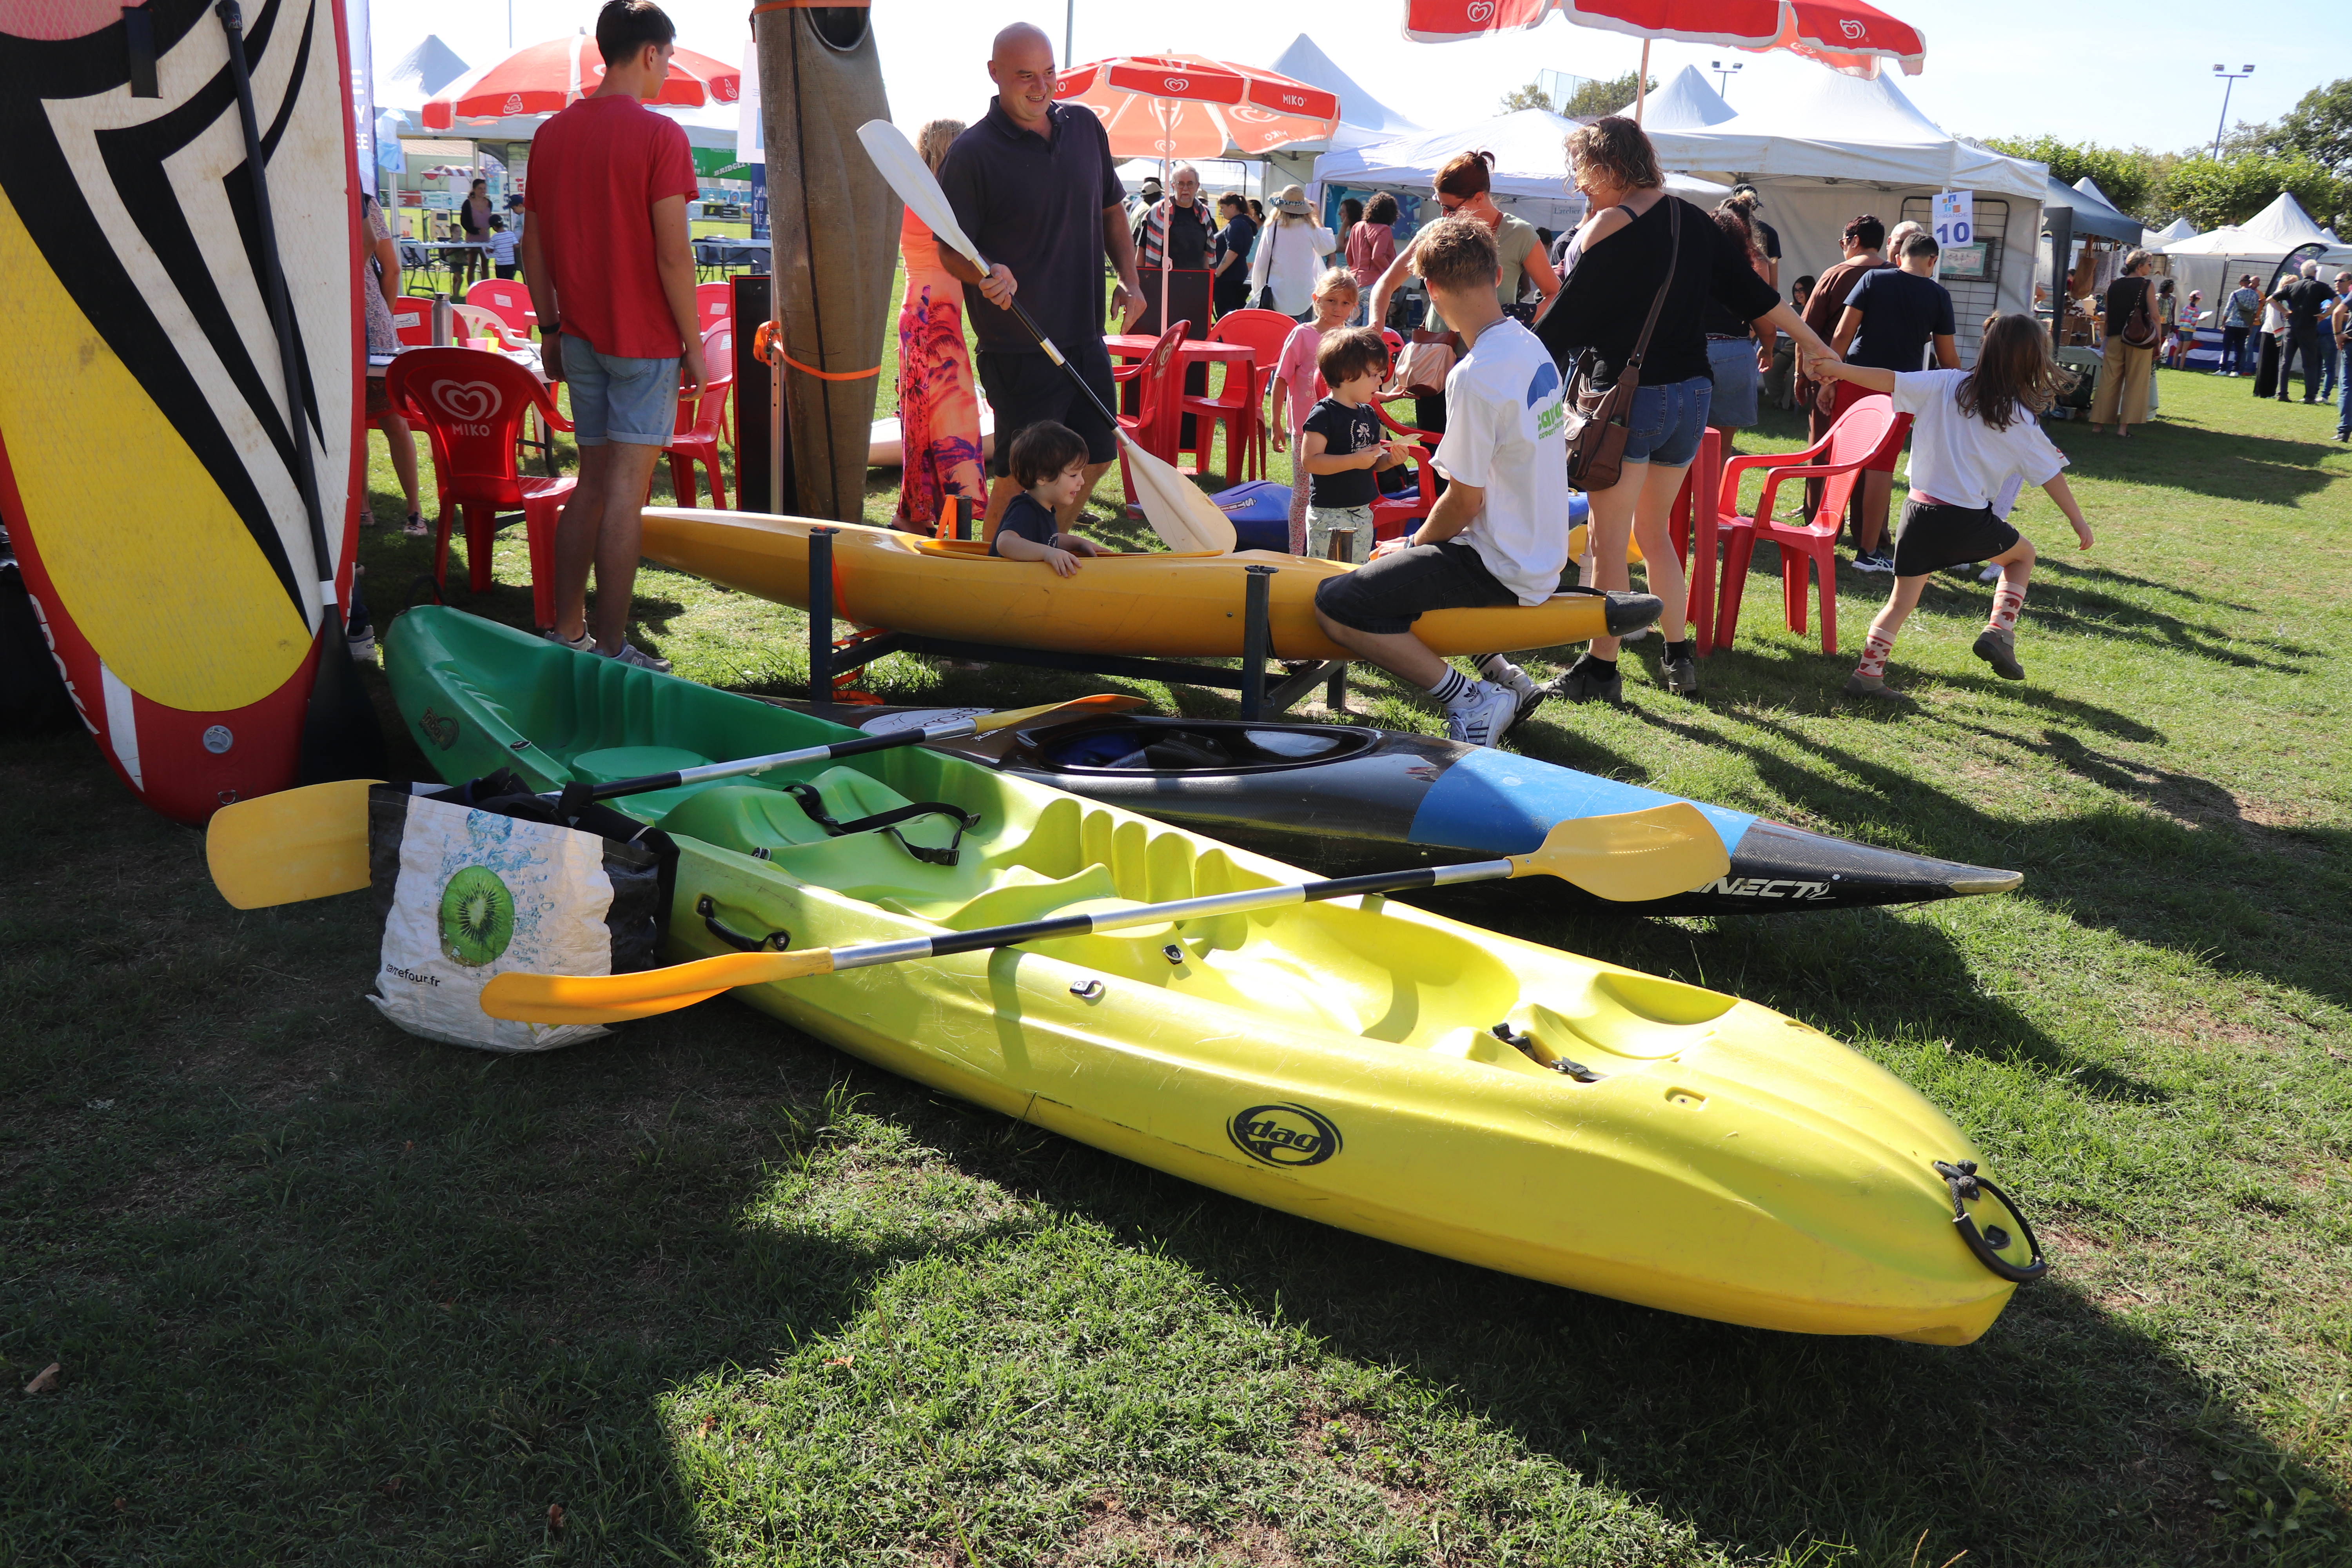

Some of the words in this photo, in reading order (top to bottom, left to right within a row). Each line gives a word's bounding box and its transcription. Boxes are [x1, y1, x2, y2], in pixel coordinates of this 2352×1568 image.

[1283, 93, 1304, 107] MIKO
[1936, 222, 1970, 243] 10
[452, 423, 490, 436] MIKO
[386, 964, 441, 987] carrefour.fr
[1247, 1120, 1321, 1153] dag
